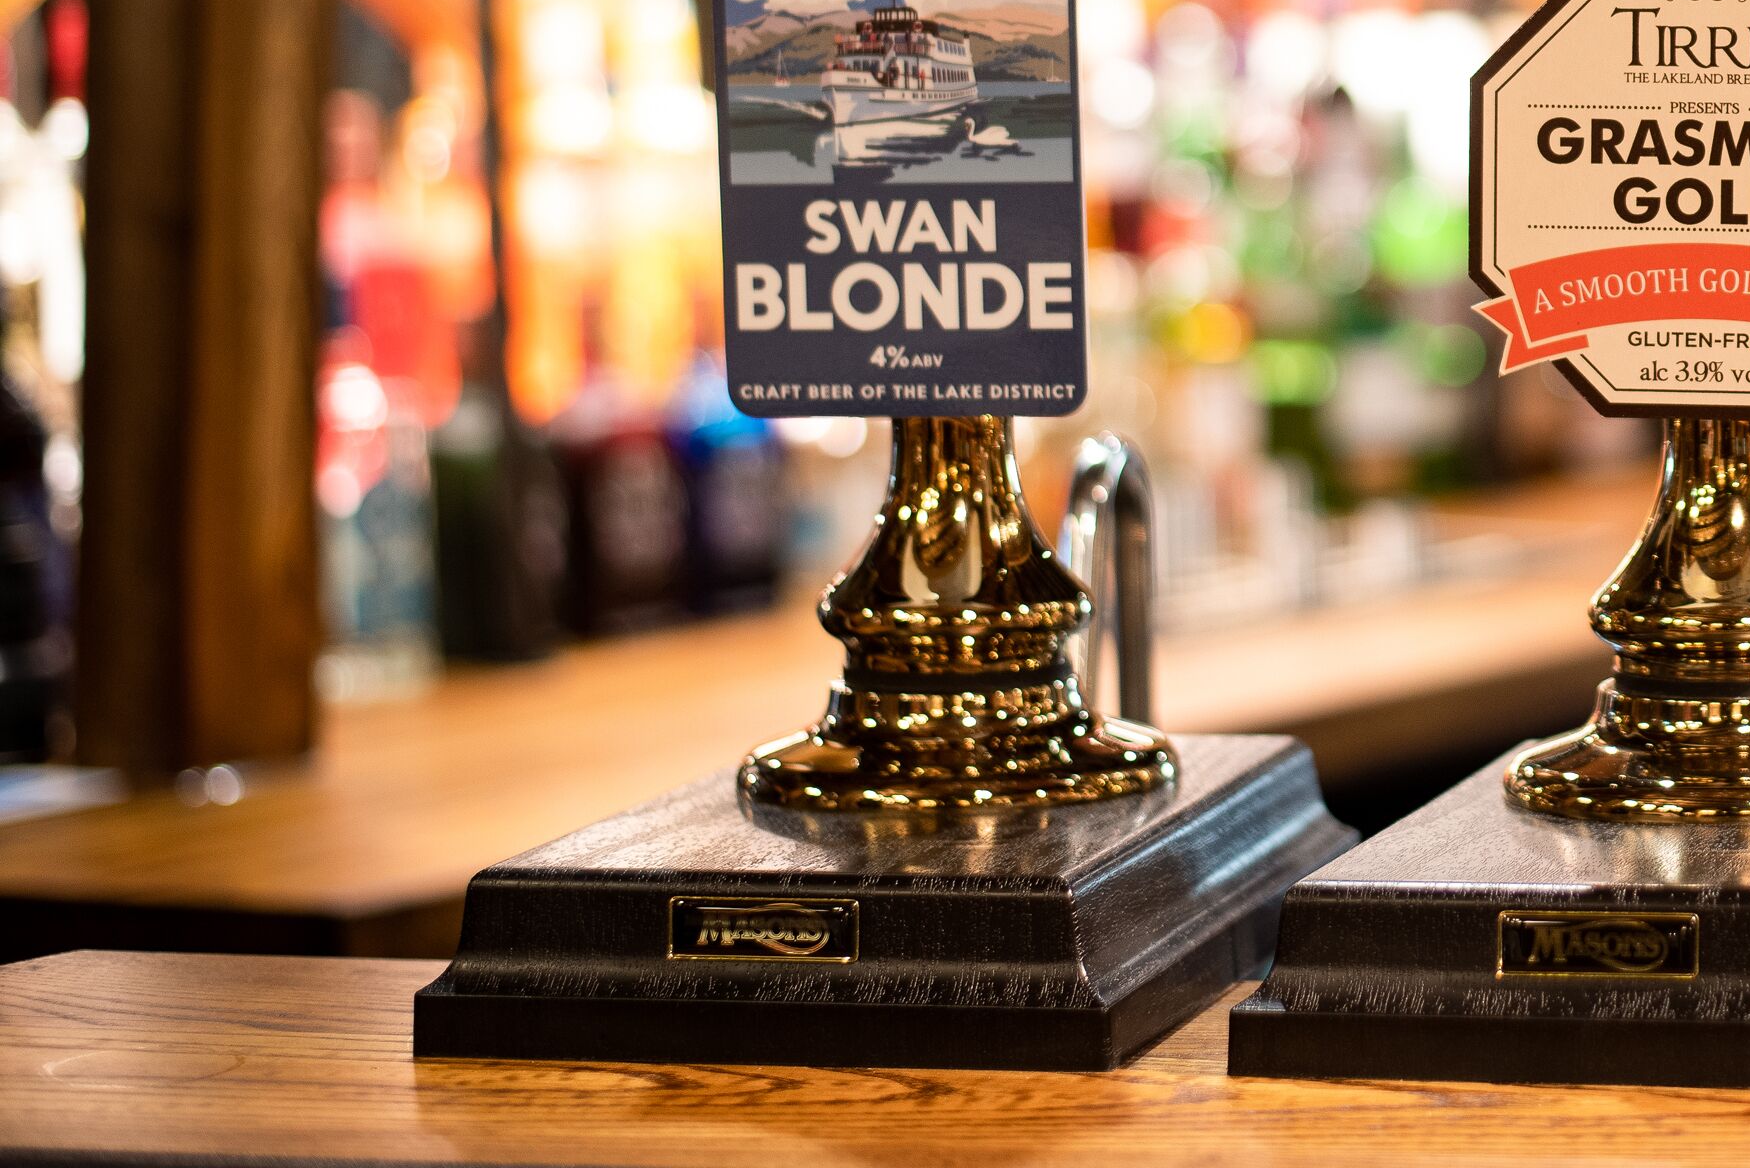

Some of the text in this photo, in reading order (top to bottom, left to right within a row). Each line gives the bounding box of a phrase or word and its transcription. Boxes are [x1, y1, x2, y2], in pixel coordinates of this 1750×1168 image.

[1624, 72, 1651, 84] THE
[1652, 72, 1724, 85] LAKELAND
[1669, 101, 1740, 115] PRESENTS
[804, 199, 997, 254] SWAN
[735, 261, 1074, 332] BLONDE
[1533, 288, 1552, 314] A
[1559, 267, 1689, 306] SMOOTH
[1639, 361, 1668, 383] alc
[1675, 360, 1725, 384] 3.9%
[740, 384, 1076, 400] CRAFT BEER OF THE LAKE DISTRICT
